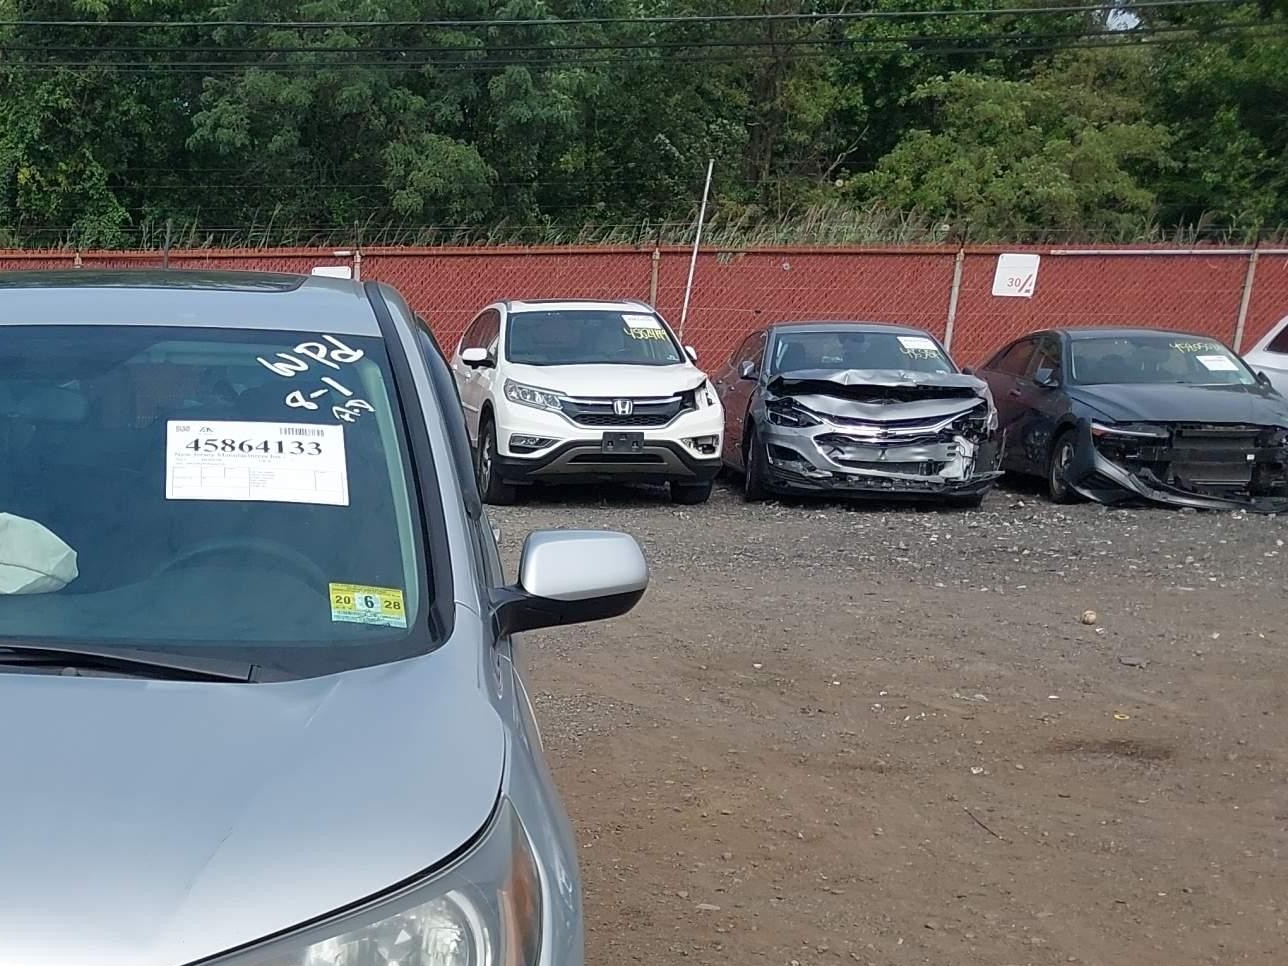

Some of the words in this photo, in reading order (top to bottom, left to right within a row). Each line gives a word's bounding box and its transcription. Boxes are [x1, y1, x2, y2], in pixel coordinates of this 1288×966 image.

[185, 437, 323, 456] 45864133
[335, 595, 351, 605] 20
[364, 595, 375, 608] 6
[384, 600, 401, 610] 28
